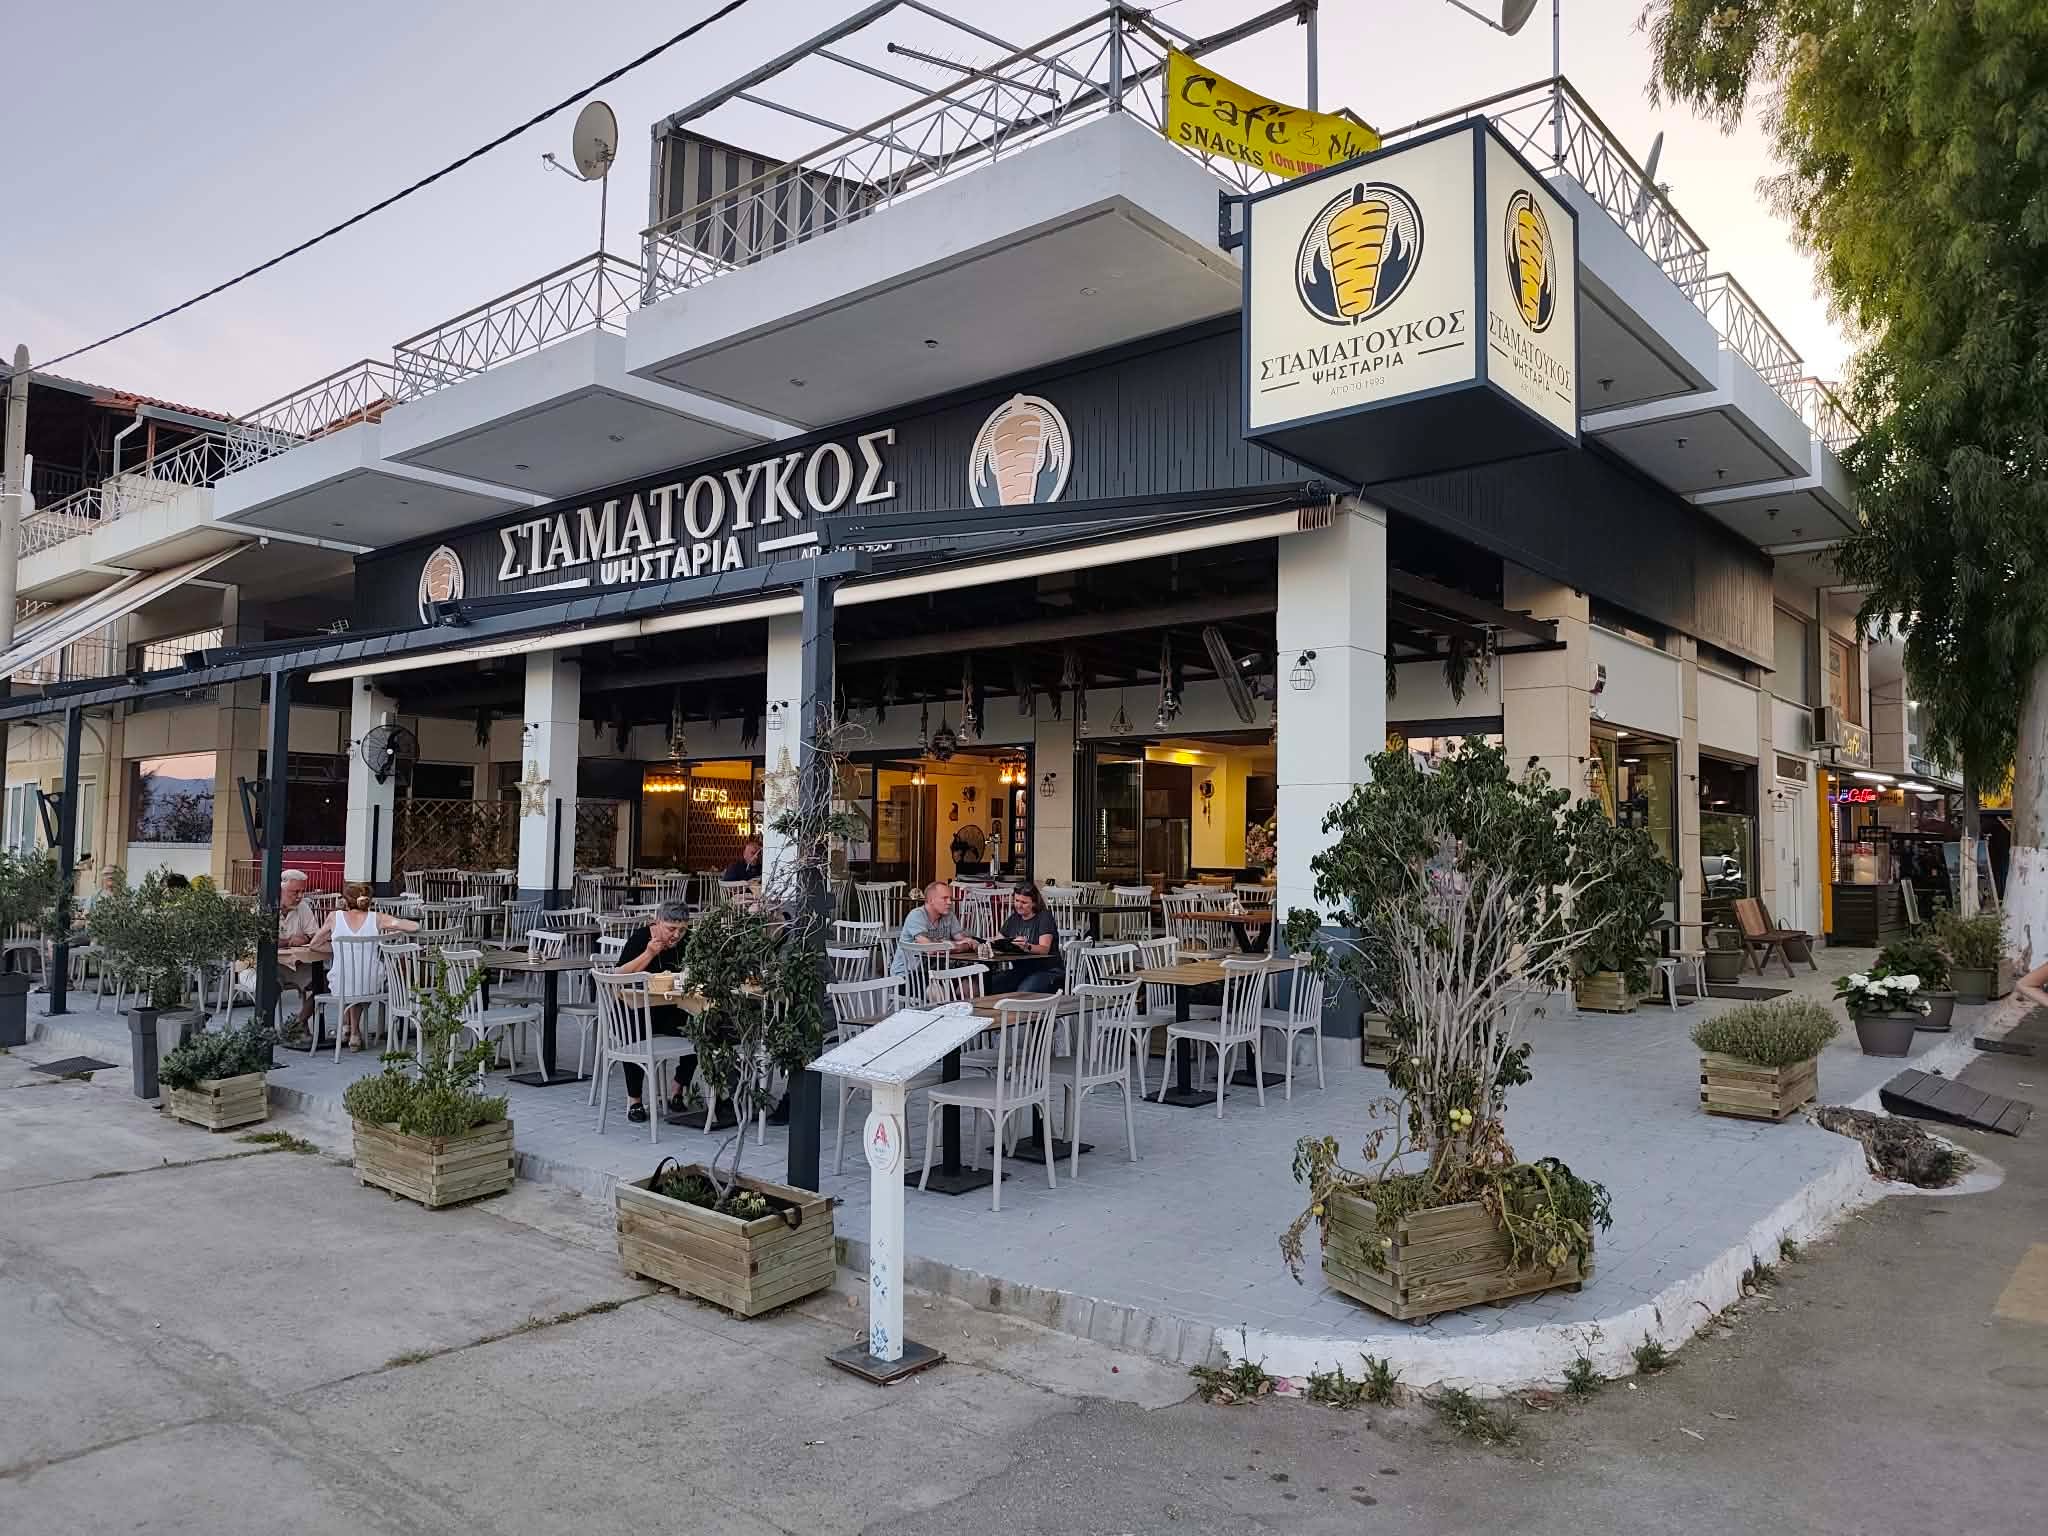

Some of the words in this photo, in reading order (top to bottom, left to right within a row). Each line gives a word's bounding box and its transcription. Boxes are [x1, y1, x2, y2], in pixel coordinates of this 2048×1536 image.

[1180, 121, 1264, 168] SNACKS
[1260, 309, 1466, 381] ΣΤΑΜΑΤΟΥΚΟΣ
[1312, 352, 1404, 385] ΨΗΣΤΑΡΙΑ
[1489, 311, 1572, 391] ΣΤΑΜΑΤΟΥΚΟΣ
[1513, 355, 1550, 393] ΨΗΣΤΑΡΙΑ
[498, 428, 897, 581] ΣΤΑΜΑΤΟΥΚΟΣ
[600, 536, 745, 585] ΨΗΣΤΑΡΙΑ
[693, 788, 728, 803] LET'S
[716, 806, 750, 820] MEAT
